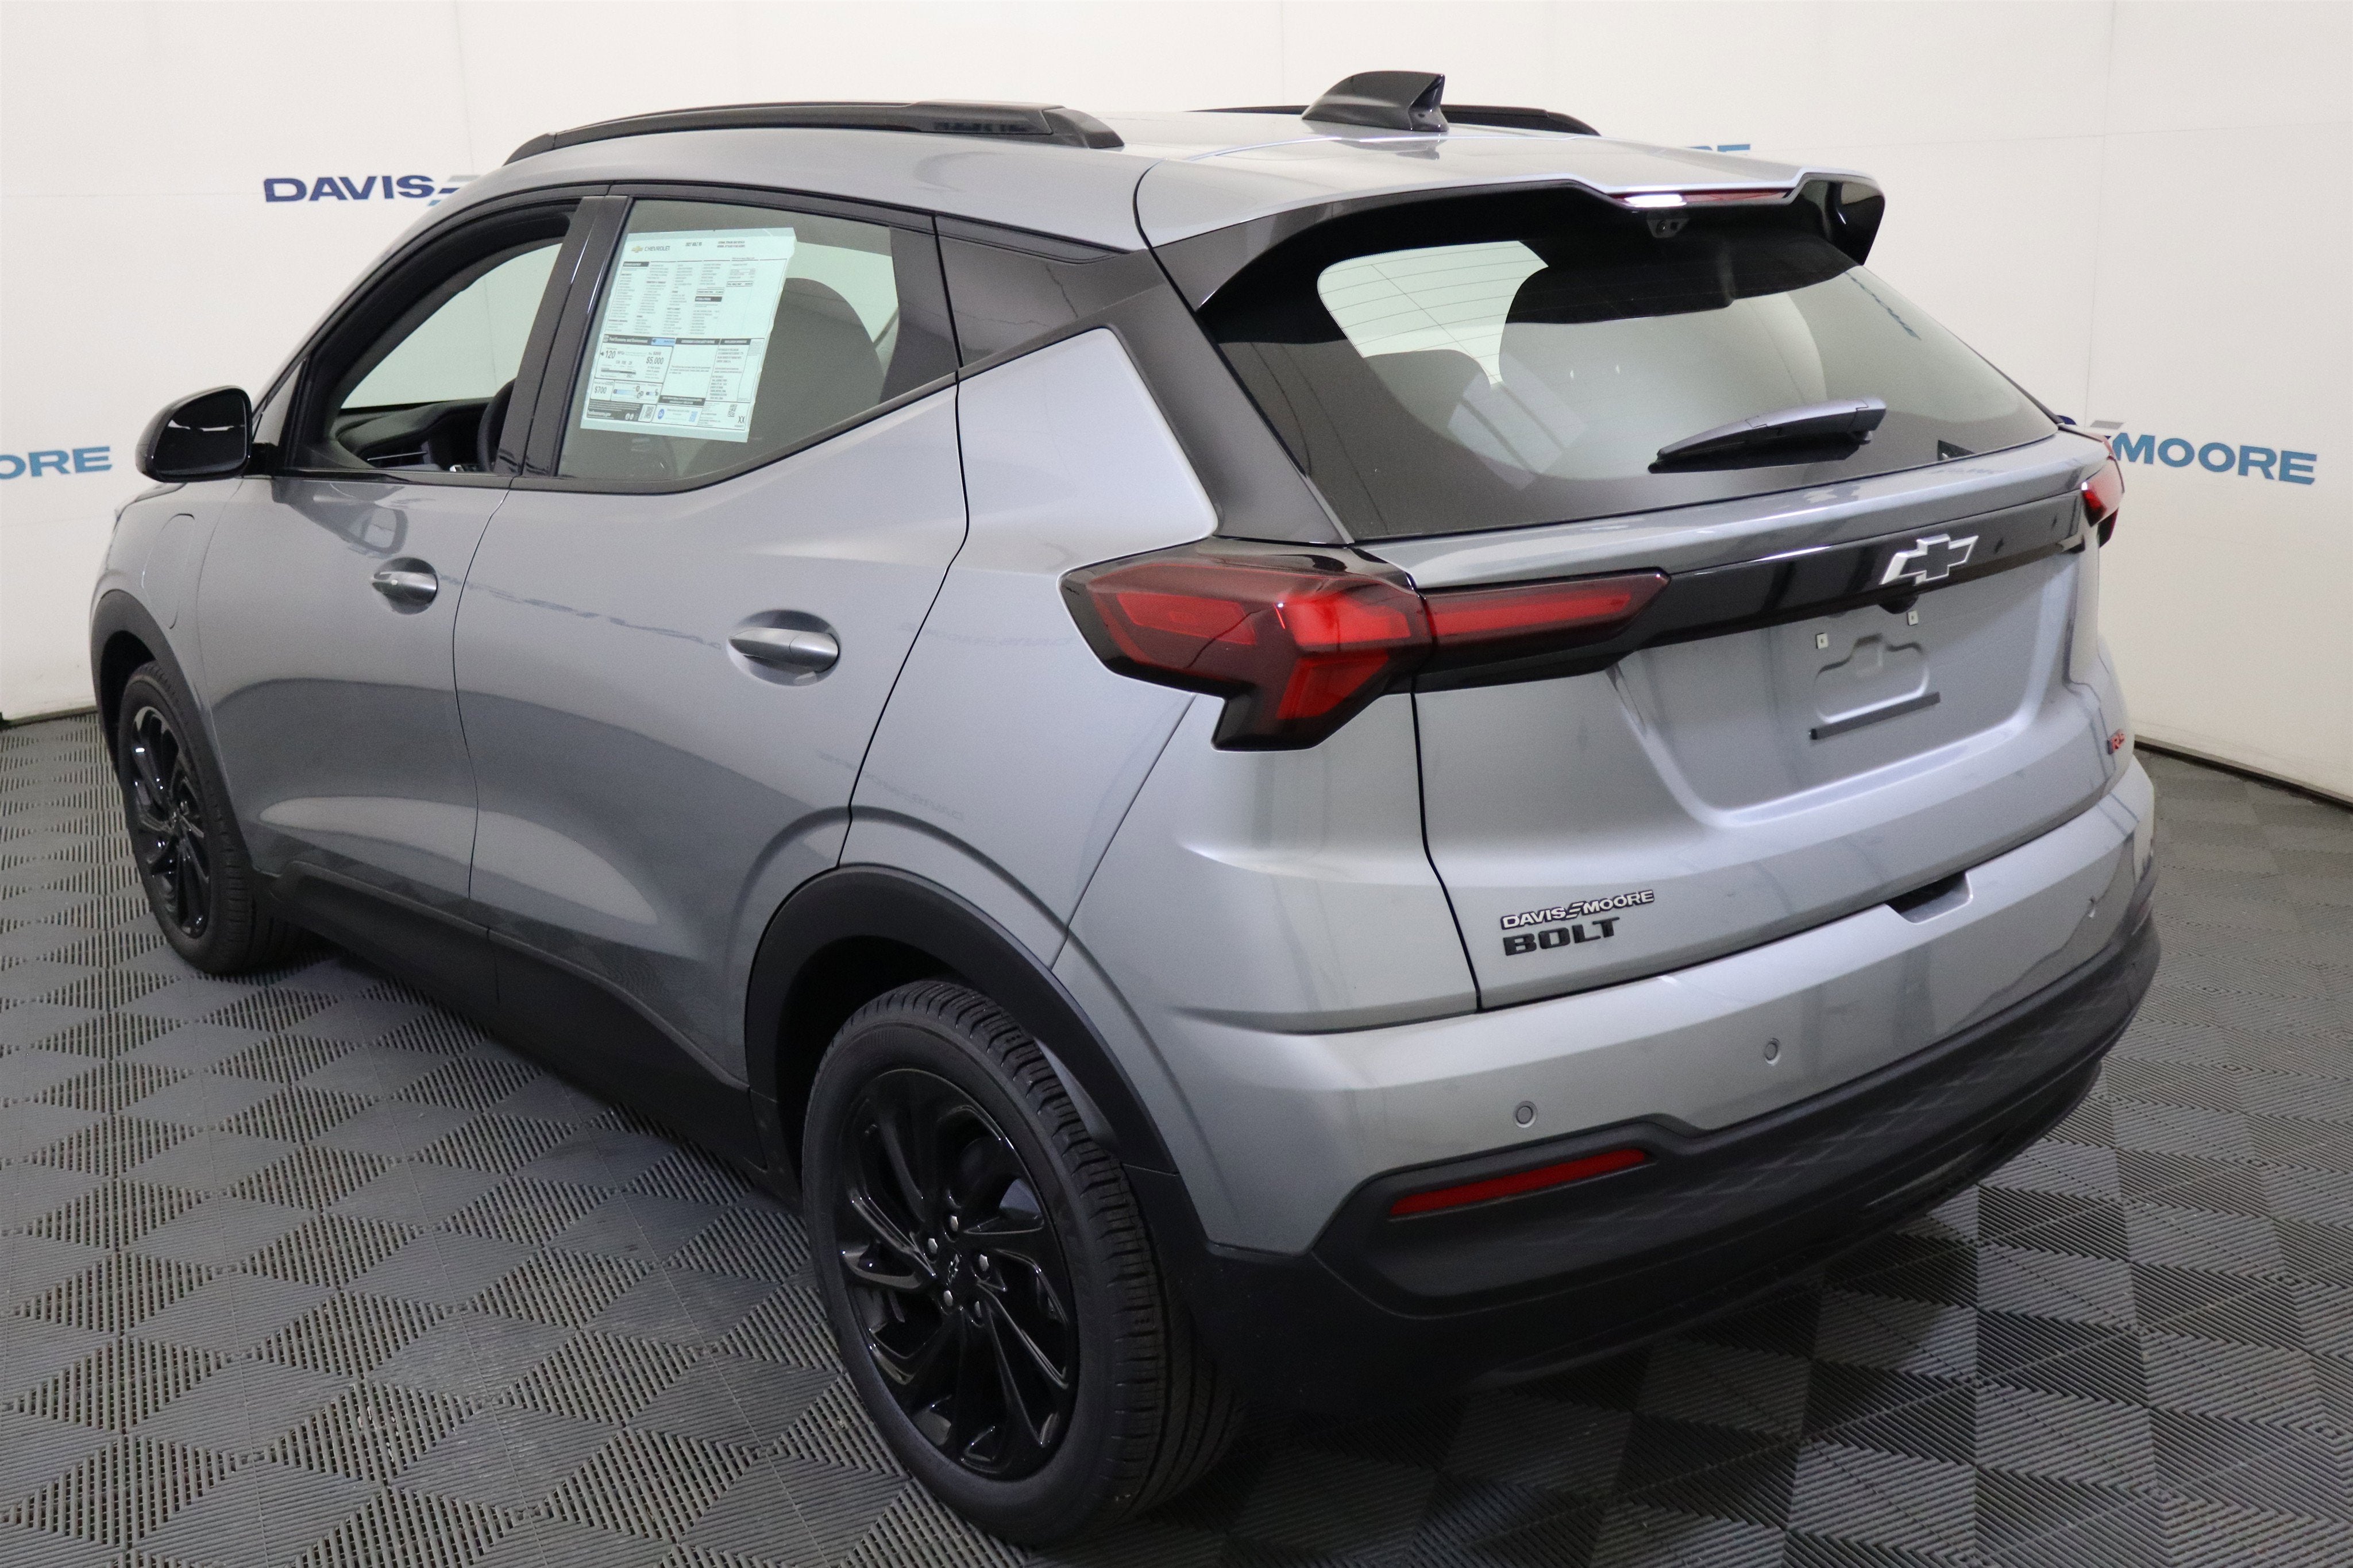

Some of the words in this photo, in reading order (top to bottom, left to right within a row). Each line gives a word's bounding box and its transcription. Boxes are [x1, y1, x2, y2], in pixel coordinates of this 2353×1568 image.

[264, 175, 434, 202] DAVIS
[605, 350, 616, 358] 120
[2112, 432, 2317, 485] MOORE
[1500, 907, 1567, 930] DAVIS
[1581, 890, 1654, 916] MOORE
[1503, 917, 1620, 956] BOLT
